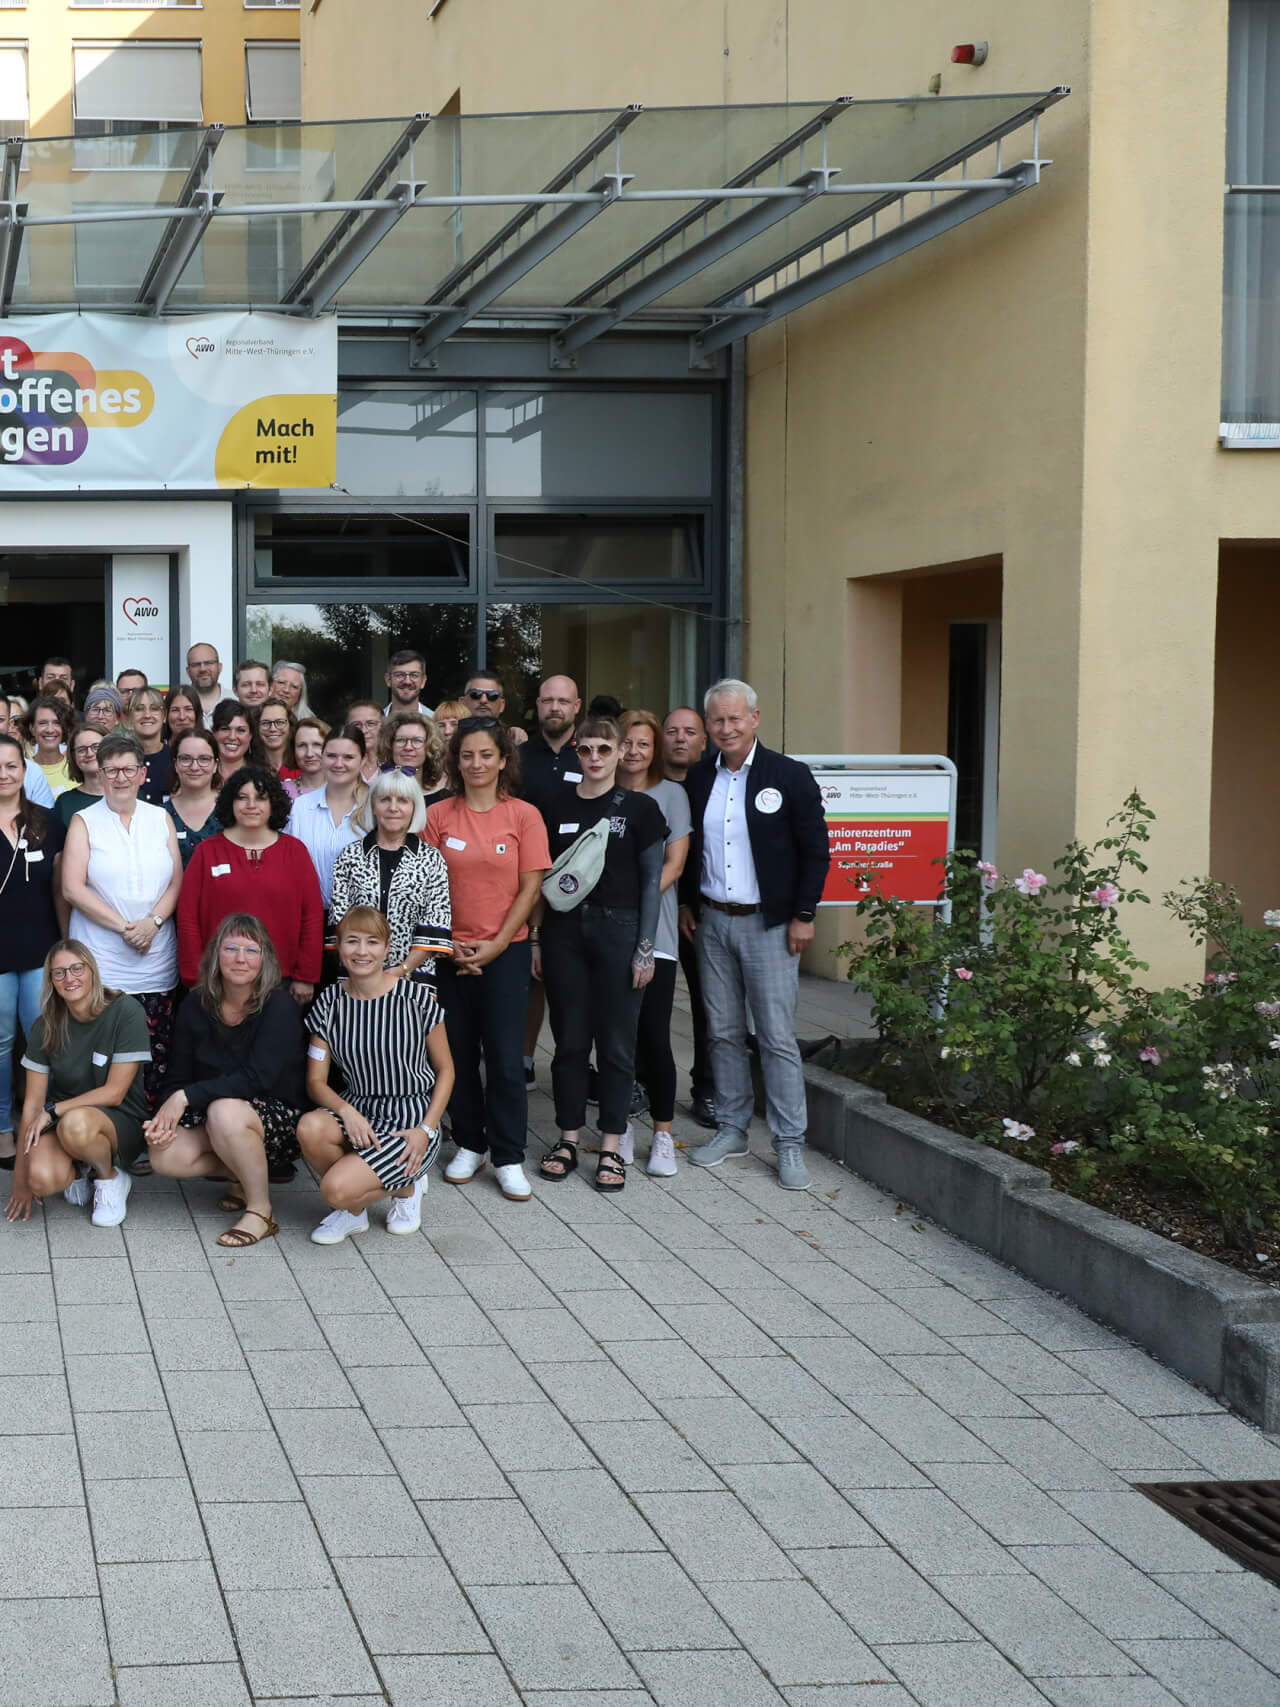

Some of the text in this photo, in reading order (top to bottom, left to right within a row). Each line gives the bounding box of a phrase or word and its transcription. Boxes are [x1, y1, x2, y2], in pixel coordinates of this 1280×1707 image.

[195, 344, 215, 352] AWO
[256, 418, 314, 437] Mach
[255, 445, 297, 463] mit!
[134, 607, 159, 617] AWO
[827, 827, 912, 838] eniorenzentrum
